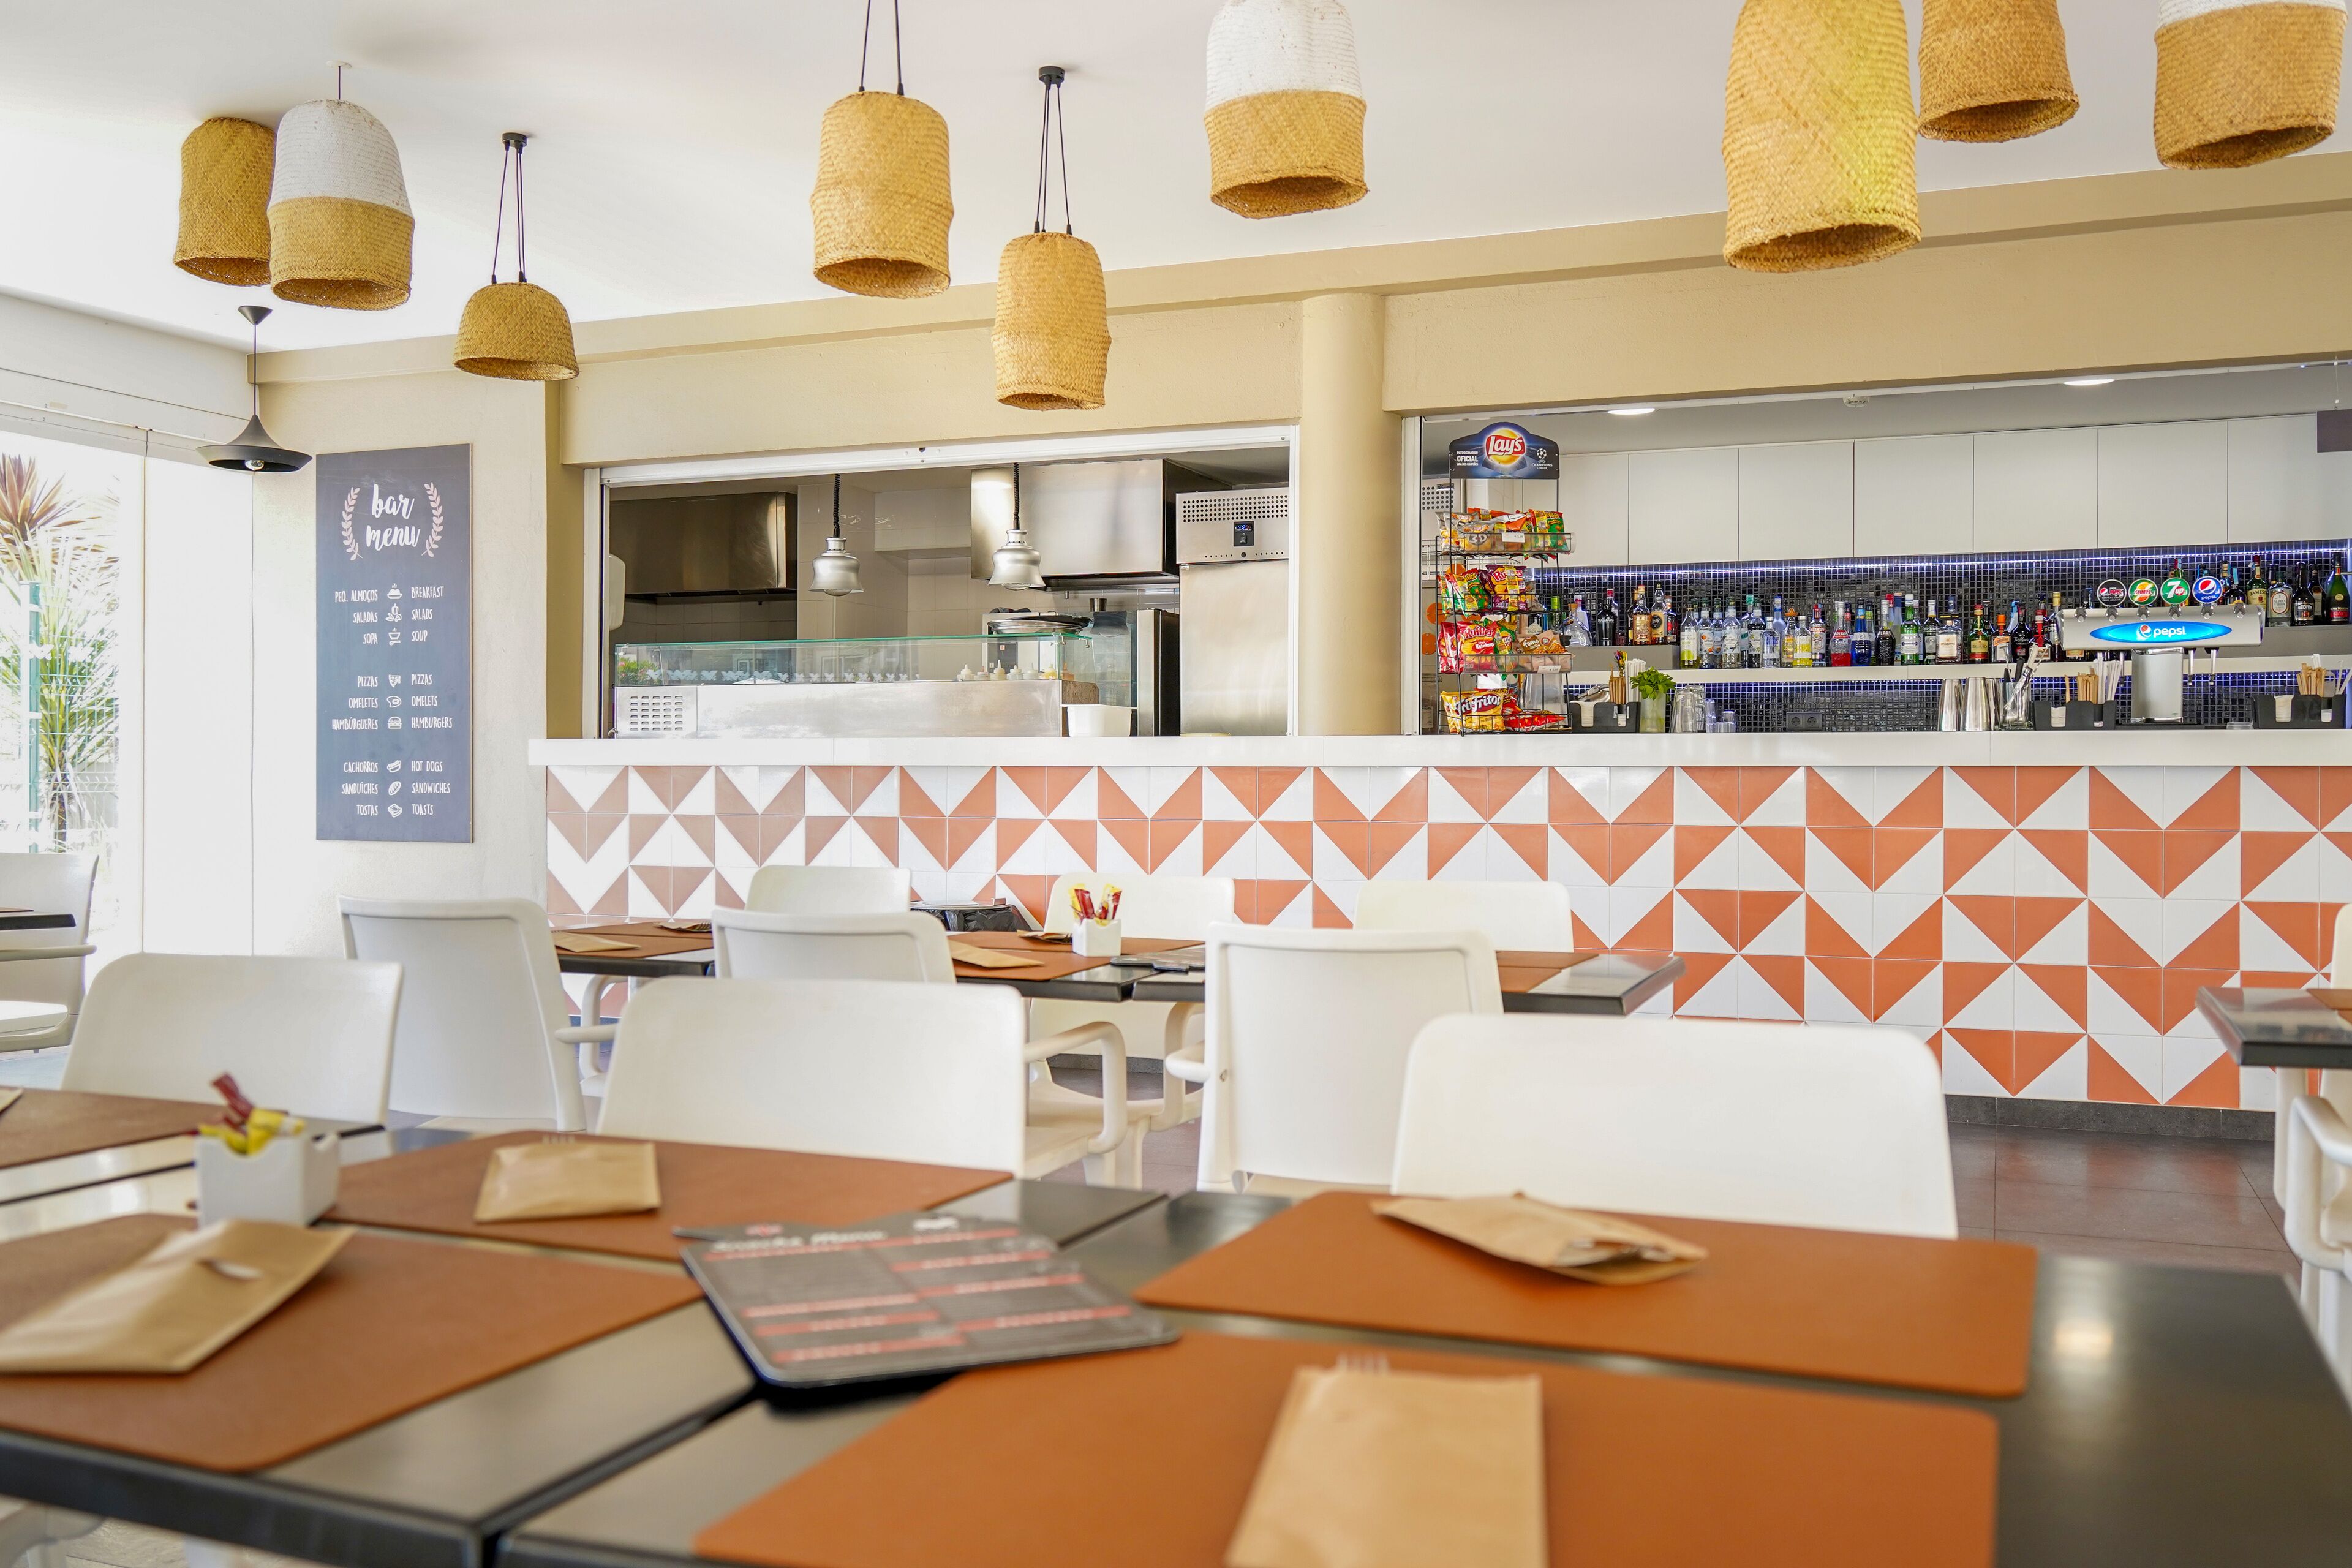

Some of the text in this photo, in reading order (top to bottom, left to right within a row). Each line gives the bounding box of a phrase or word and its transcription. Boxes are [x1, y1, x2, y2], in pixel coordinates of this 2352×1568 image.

[1488, 435, 1523, 456] Lay's
[372, 484, 415, 519] bar
[366, 526, 420, 551] menu
[1491, 570, 1523, 581] Rues
[335, 590, 377, 603] PEQ. ALMOÇOS
[412, 586, 443, 598] BREAKFAST
[353, 612, 377, 623] SALADAS
[412, 609, 432, 620] SALADS
[412, 630, 428, 641] SOUP
[2154, 626, 2186, 638] pepsi
[363, 633, 377, 644] SOPA
[358, 676, 377, 687] PIZZAS
[412, 674, 432, 685] PIZZAS
[349, 698, 378, 708] OMELETES
[412, 696, 437, 706] OMELETS
[1470, 695, 1501, 712] Fritos
[333, 717, 378, 730] HAMBÚRGUERES
[412, 717, 452, 728] HAMBURGERS
[344, 761, 378, 772] CACHORROS
[412, 761, 442, 772] HOT DOGS
[342, 782, 378, 794] SANDUÍCHES
[412, 783, 450, 793] SANDWICHES
[356, 805, 378, 816] TOSTAS
[412, 804, 433, 815] TOASTS
